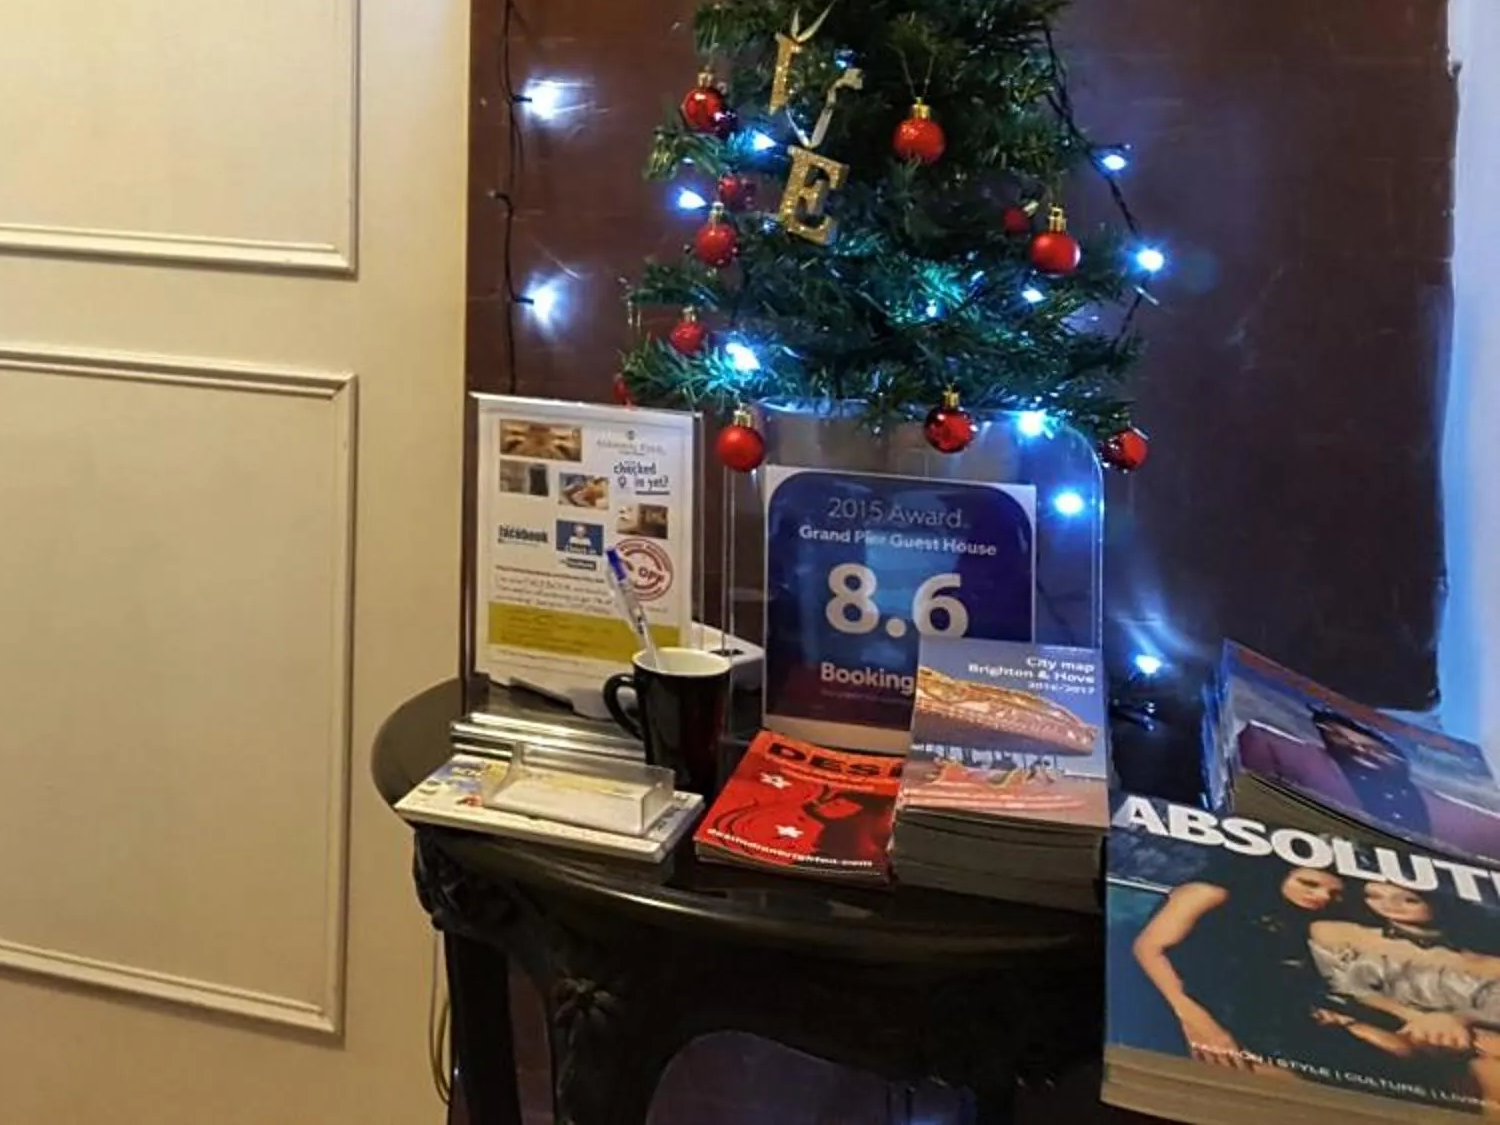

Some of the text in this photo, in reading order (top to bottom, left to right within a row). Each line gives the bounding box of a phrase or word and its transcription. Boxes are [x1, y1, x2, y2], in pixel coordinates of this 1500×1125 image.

[828, 497, 963, 529] 2015 Award
[799, 525, 997, 556] Grand Pier Guest House
[825, 562, 970, 639] 8.6
[820, 661, 915, 696] Booking
[968, 662, 1033, 679] Brighton
[1036, 669, 1049, 680] &
[1026, 655, 1095, 674] City map
[1276, 1057, 1331, 1078] STYLE
[1344, 1068, 1427, 1098] CULTURE
